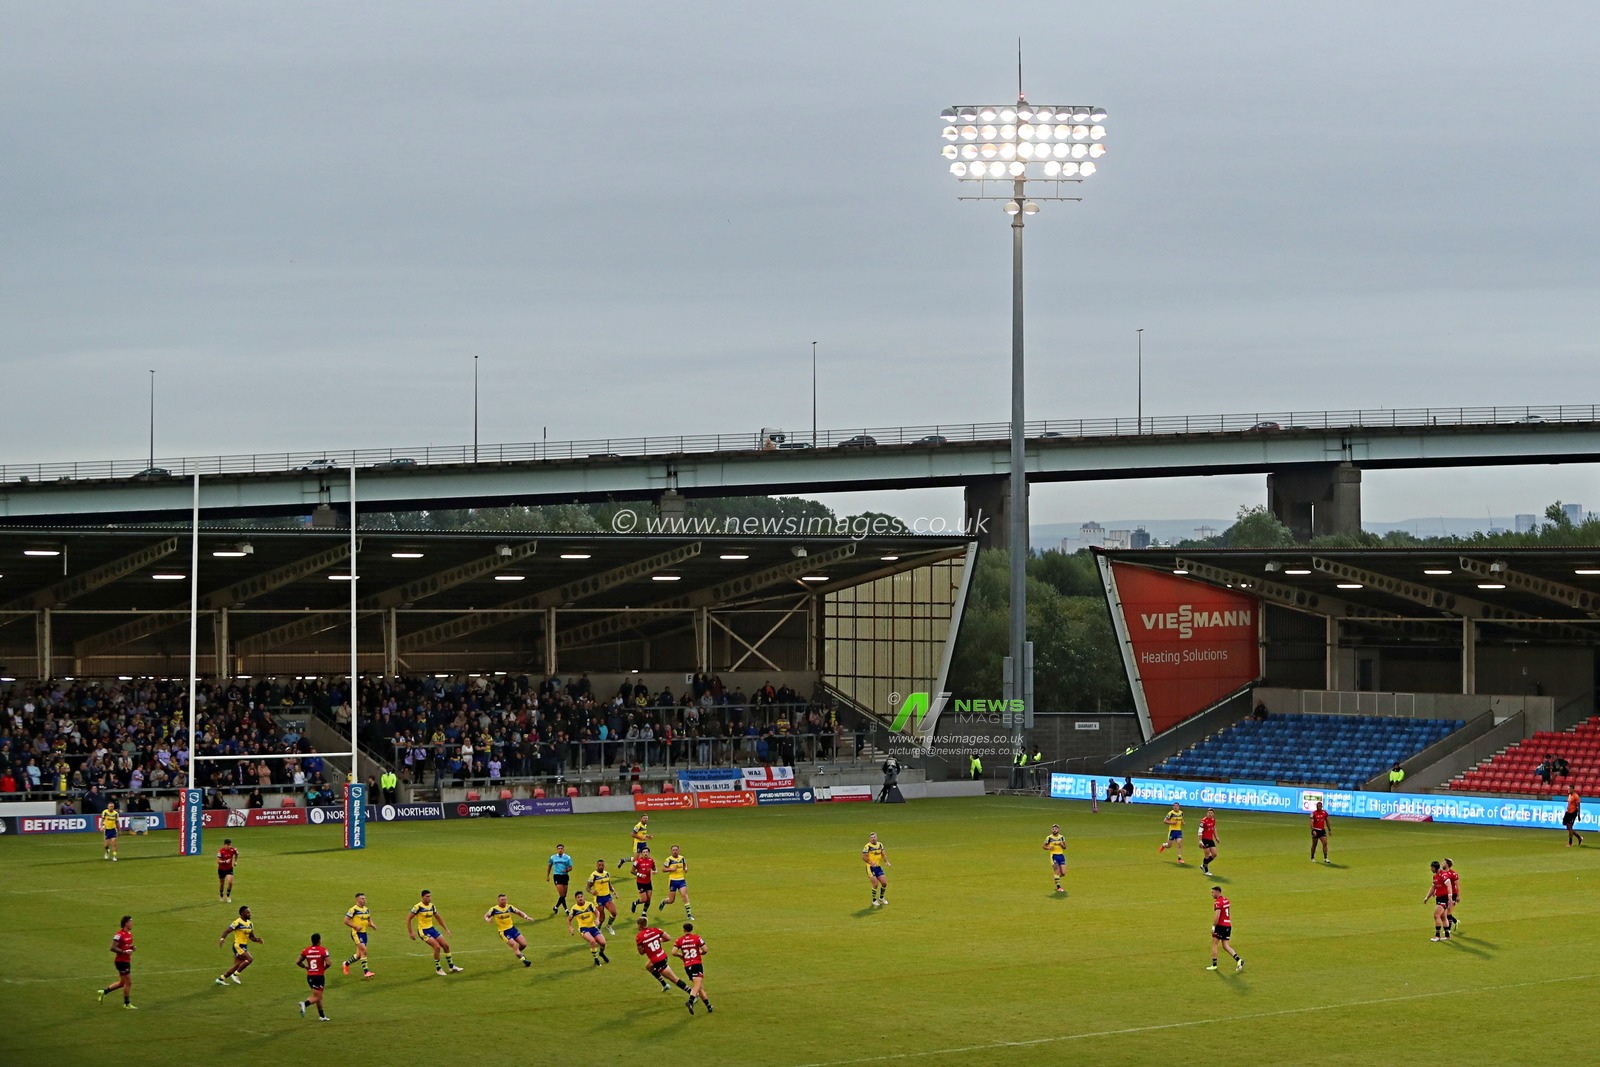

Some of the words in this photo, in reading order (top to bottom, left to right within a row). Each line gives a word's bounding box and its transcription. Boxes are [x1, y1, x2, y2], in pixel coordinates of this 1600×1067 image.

[1141, 605, 1251, 639] VIESSMANN
[1141, 650, 1180, 665] Heating
[1183, 648, 1228, 662] Solutions
[1169, 789, 1187, 800] part
[1190, 790, 1198, 800] of
[1201, 789, 1226, 803] Circle
[1229, 791, 1259, 805] Health
[1261, 793, 1291, 808] Group
[397, 806, 440, 817] NORTHERN
[1370, 799, 1414, 814] Highfield
[1417, 802, 1462, 818] Hospital,
[1464, 806, 1484, 819] part
[1487, 806, 1498, 818] of
[1500, 806, 1530, 822] Circle
[24, 818, 87, 831] BETFRED
[648, 939, 660, 952] 18
[683, 948, 698, 959] 28
[310, 959, 318, 970] 6
